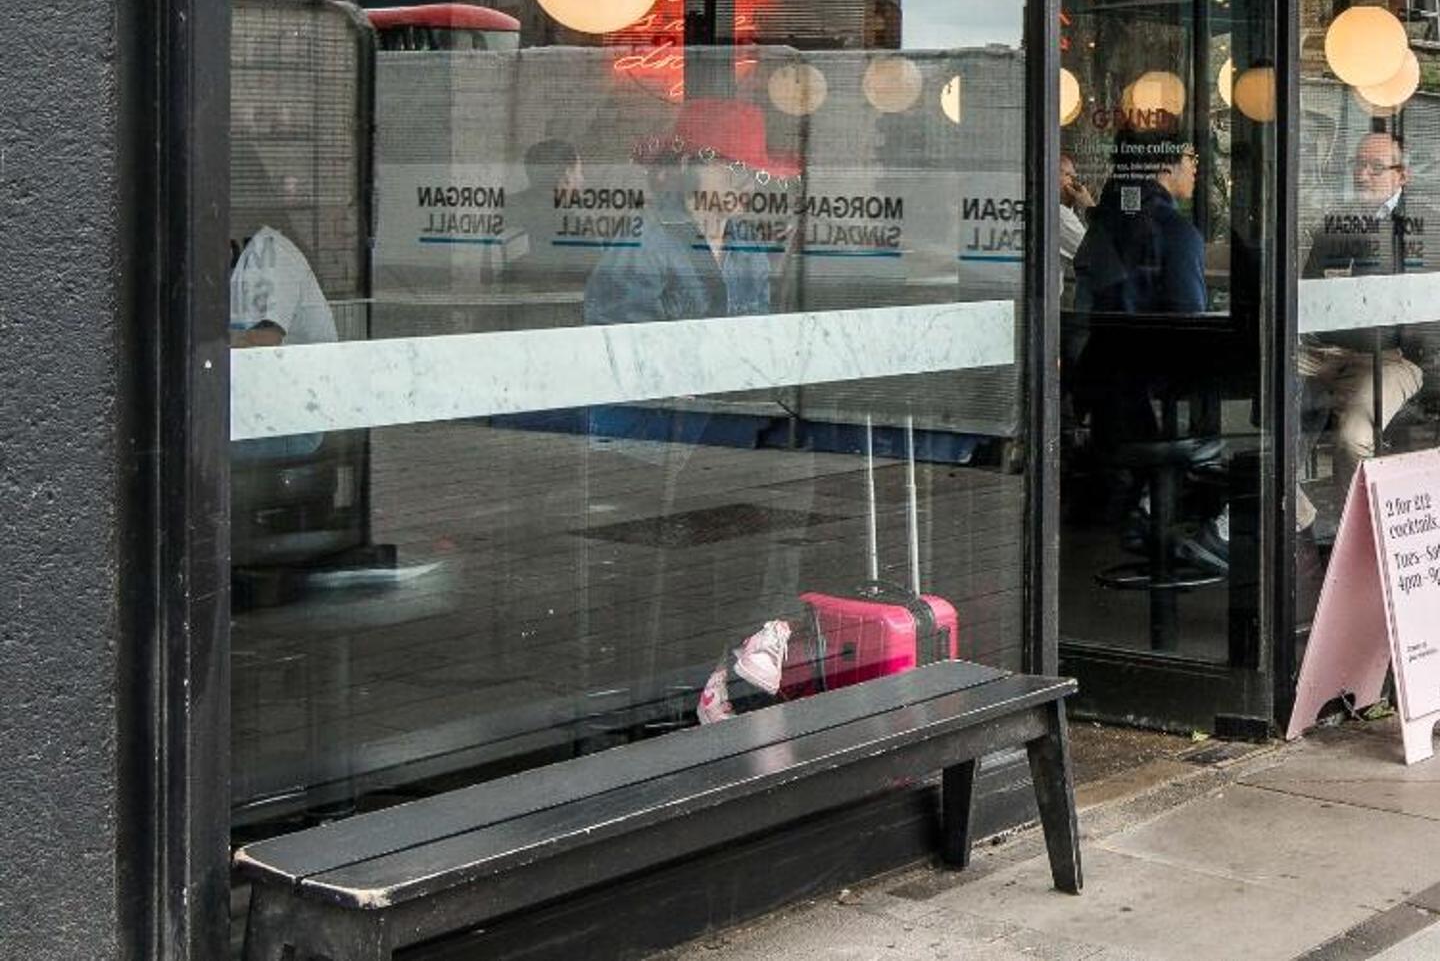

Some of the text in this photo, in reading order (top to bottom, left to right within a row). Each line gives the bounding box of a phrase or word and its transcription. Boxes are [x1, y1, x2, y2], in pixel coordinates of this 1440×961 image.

[1120, 141, 1145, 154] free
[1385, 500, 1395, 518] 2
[1395, 497, 1412, 516] for
